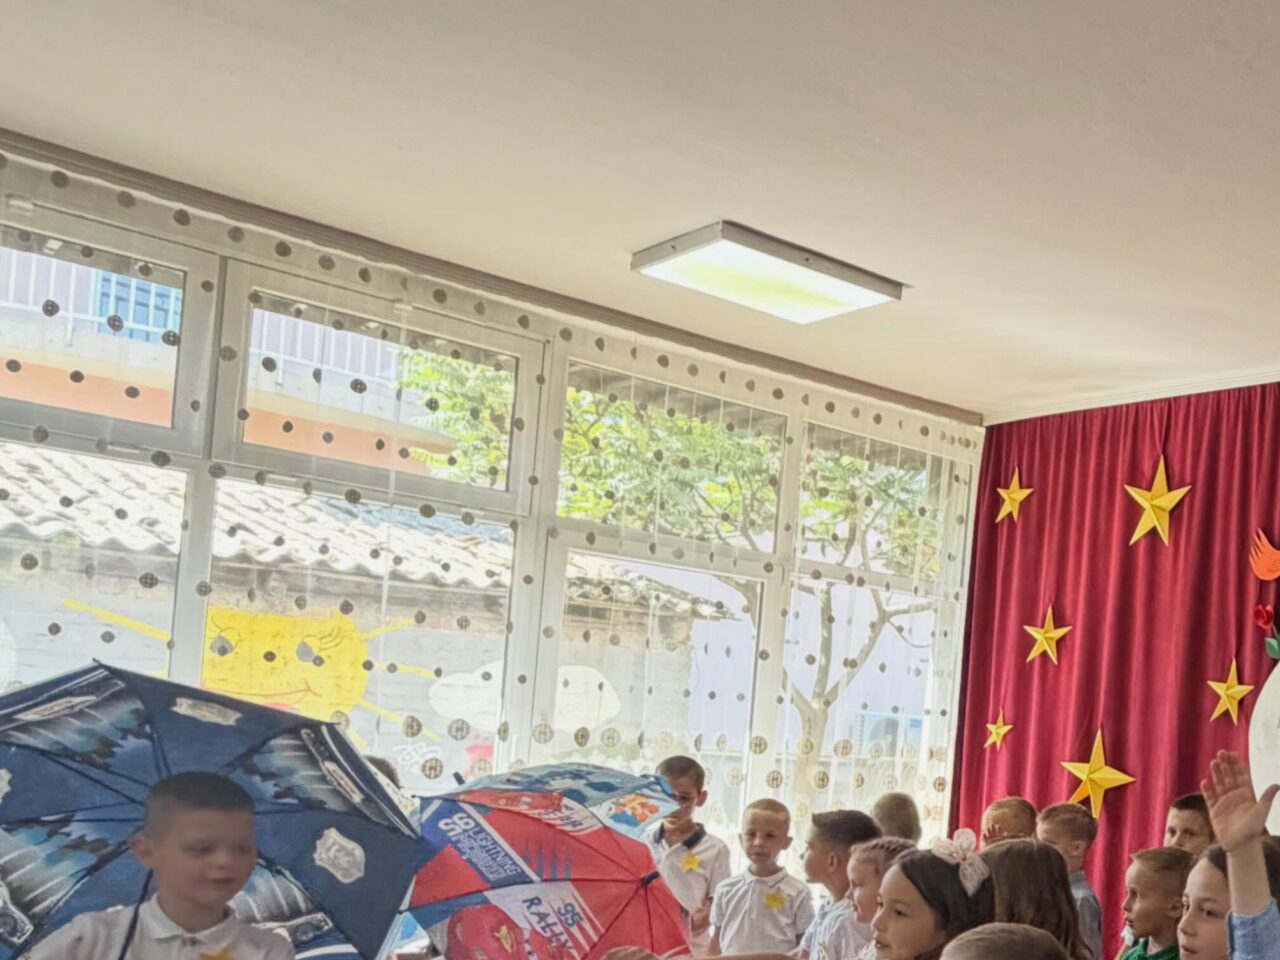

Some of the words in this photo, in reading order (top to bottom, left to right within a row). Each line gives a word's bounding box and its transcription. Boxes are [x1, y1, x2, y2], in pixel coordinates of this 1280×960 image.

[468, 824, 522, 877] LIGHTNING
[522, 896, 574, 953] RALLY
[556, 902, 585, 929] 95
